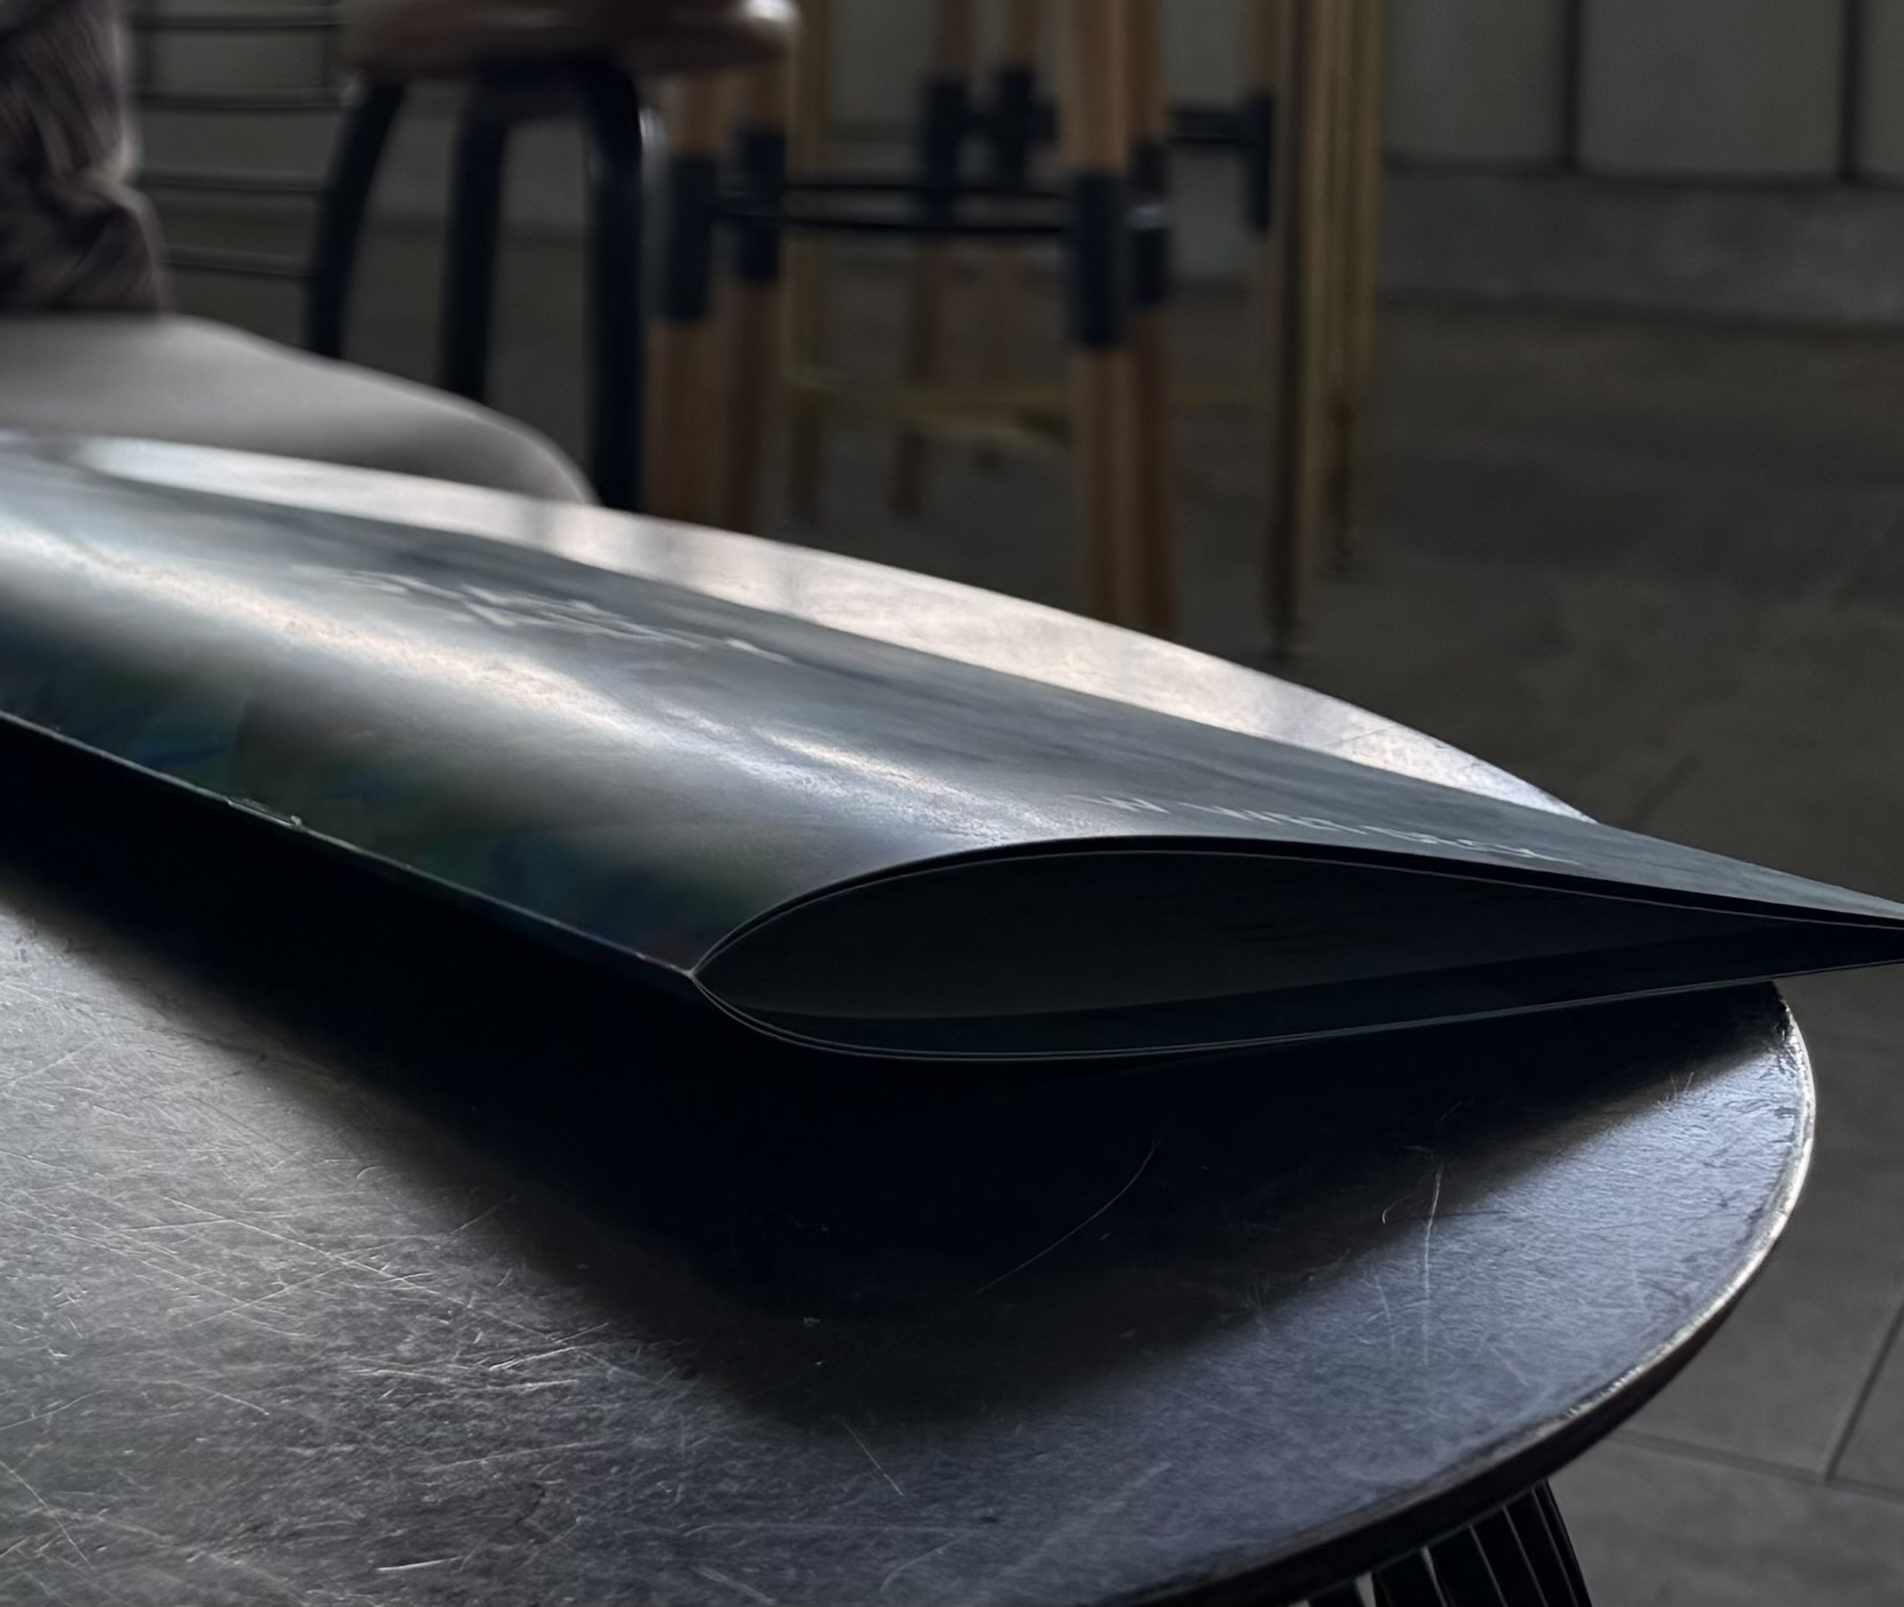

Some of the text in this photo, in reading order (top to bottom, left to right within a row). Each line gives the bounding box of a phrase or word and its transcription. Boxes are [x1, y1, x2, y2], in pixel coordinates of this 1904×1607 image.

[1068, 794, 1582, 866] W WET DECK
